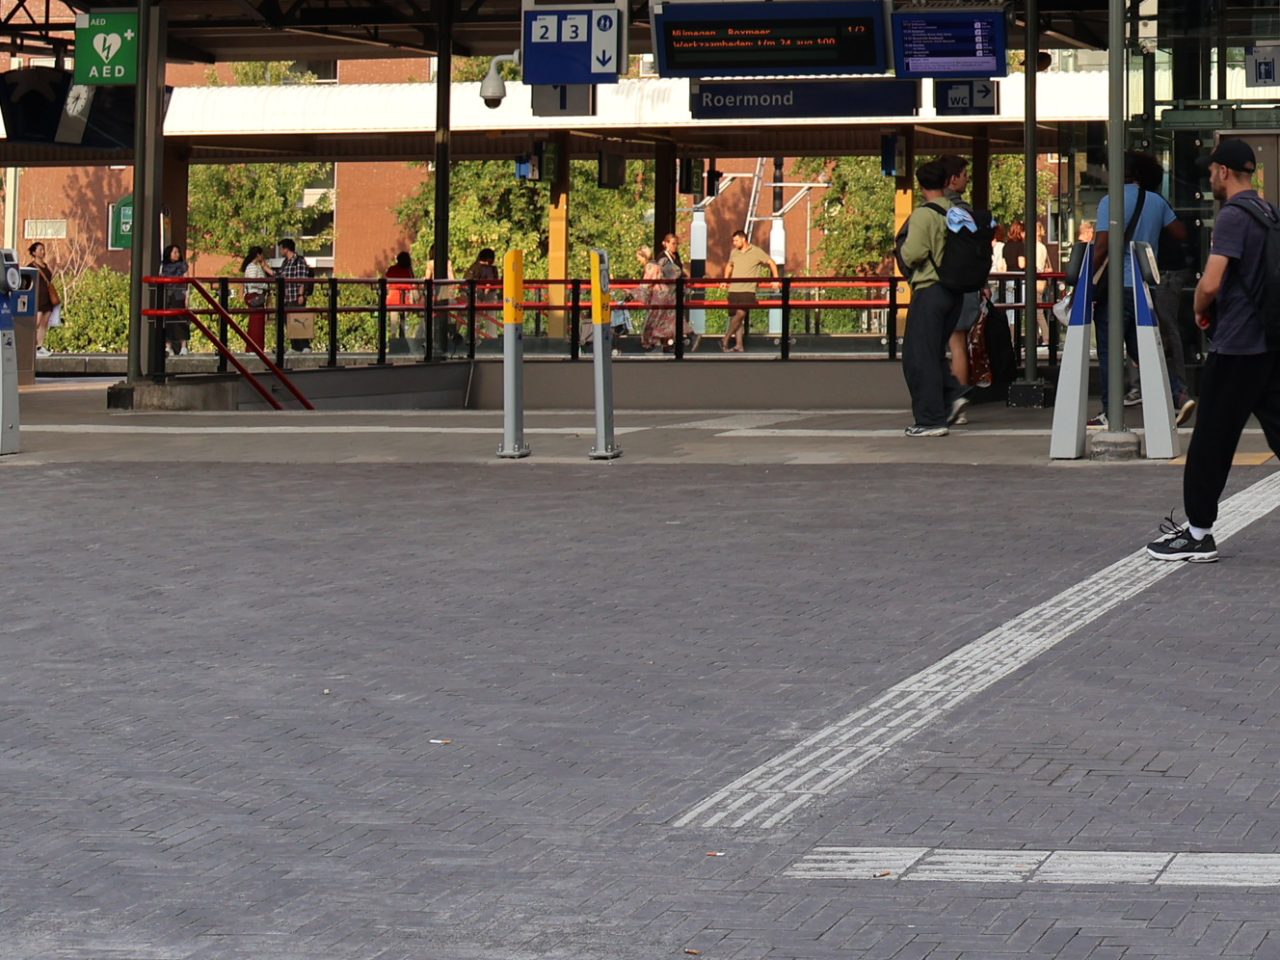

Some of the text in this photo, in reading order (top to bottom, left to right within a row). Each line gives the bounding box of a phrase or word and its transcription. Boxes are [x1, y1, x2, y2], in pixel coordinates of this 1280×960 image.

[90, 18, 106, 26] AED
[539, 24, 579, 40] 2 3
[88, 65, 125, 78] AED
[702, 91, 794, 107] Roermond
[950, 96, 968, 106] WC
